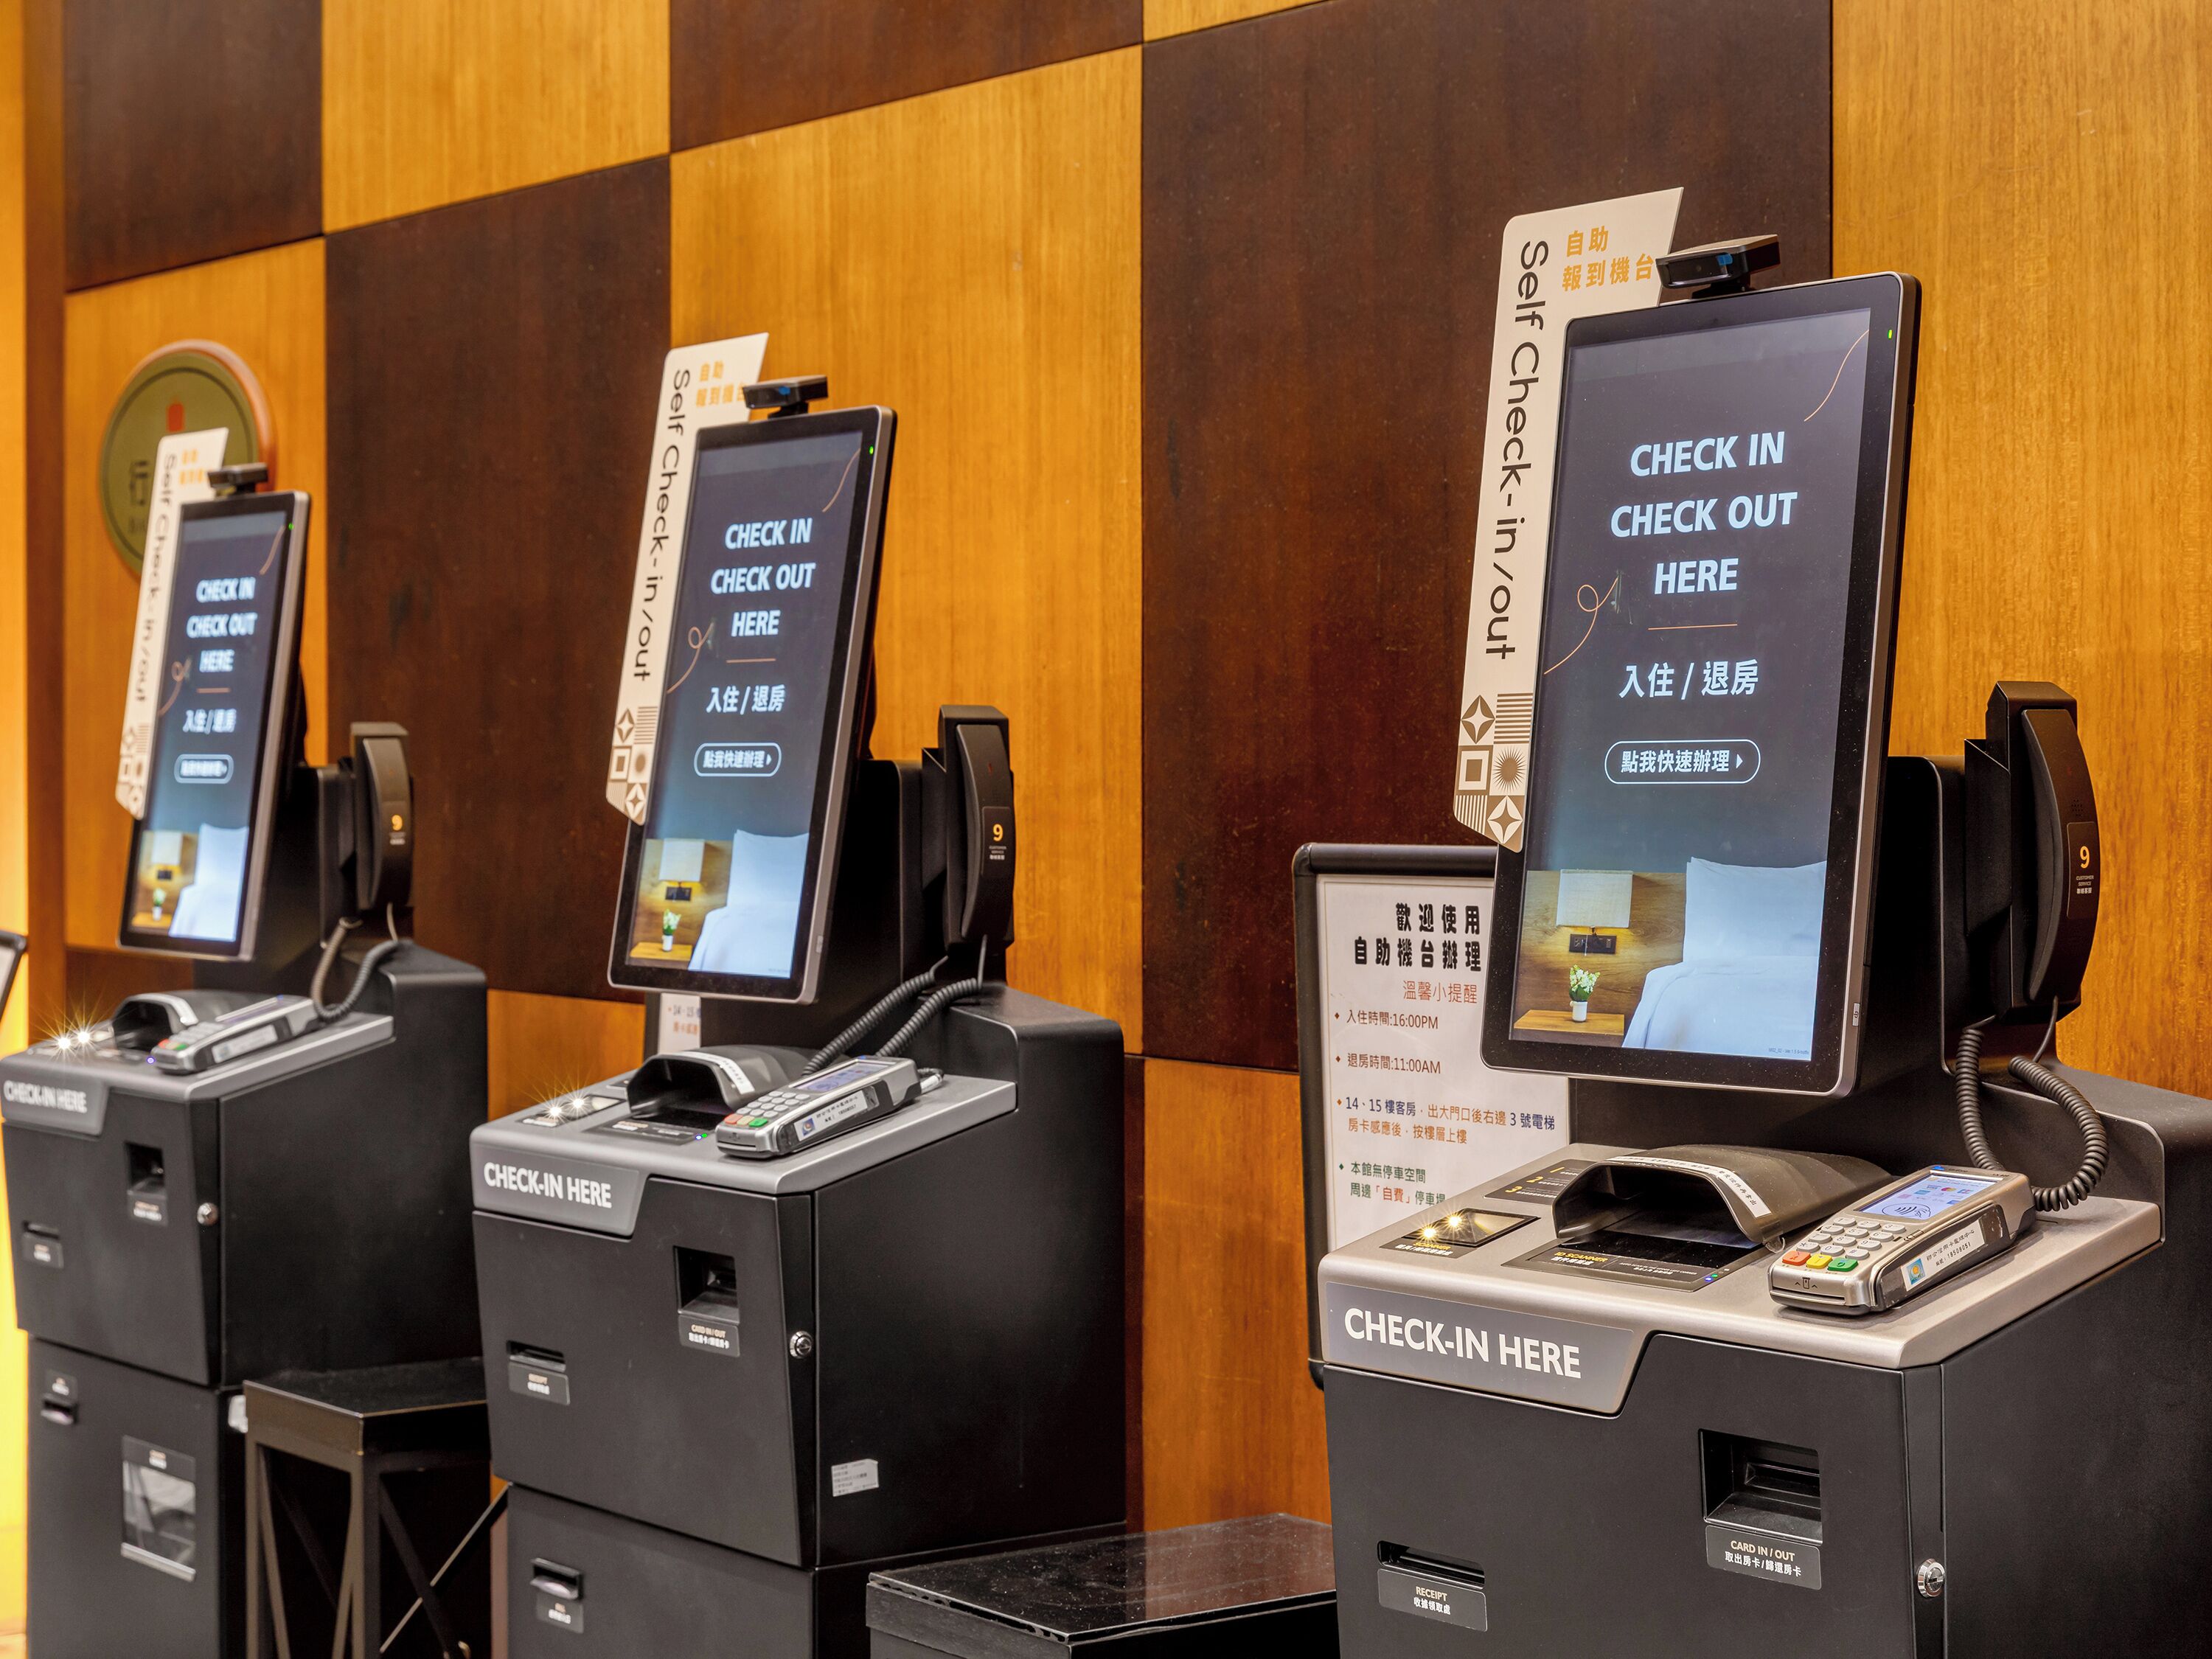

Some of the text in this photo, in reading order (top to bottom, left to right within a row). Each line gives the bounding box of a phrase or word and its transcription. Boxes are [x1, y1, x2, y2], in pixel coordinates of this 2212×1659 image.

[1566, 226, 1609, 257] 自助
[1514, 240, 1549, 331] Self
[1562, 253, 1655, 292] 報到機台
[667, 369, 690, 435] Self
[1630, 431, 1785, 477] CHECK IN
[1610, 492, 1798, 538] CHECK OUT
[725, 518, 813, 549] CHECK IN
[196, 576, 257, 603] CHECK IN
[711, 563, 816, 594] CHECK OUT
[1654, 558, 1739, 595] HERE
[187, 612, 258, 639] CHECK OUT
[731, 610, 781, 636] HERE
[199, 649, 235, 672] HERE
[1619, 663, 1674, 699] 入住
[1701, 659, 1759, 697] 退房
[1621, 748, 1730, 774] 點我快速辦理
[993, 824, 1004, 841] 9
[2080, 846, 2090, 869] 9
[1396, 902, 1480, 935] 歡迎使用
[1354, 936, 1481, 972] 自助機台辦理
[1402, 980, 1477, 1004] 溫馨小提醒
[1346, 1009, 1439, 1029] 入住時間:16:00PM
[1347, 1052, 1441, 1074] 退房時間:11:00AM
[3, 1079, 87, 1114] CHECK-IN HERE
[484, 1162, 612, 1208] CHECK-IN HERE
[1351, 1161, 1426, 1183] 本館無停車空間
[1565, 1253, 1608, 1262] SCANNER
[1344, 1308, 1582, 1379] CHECK-IN HERE
[1725, 1551, 1802, 1577] 取出房卡/歸還房卡
[1731, 1540, 1756, 1554] CARD
[1758, 1545, 1768, 1557] IN
[1775, 1549, 1795, 1562] OUT
[1416, 1586, 1447, 1601] RECEIPT
